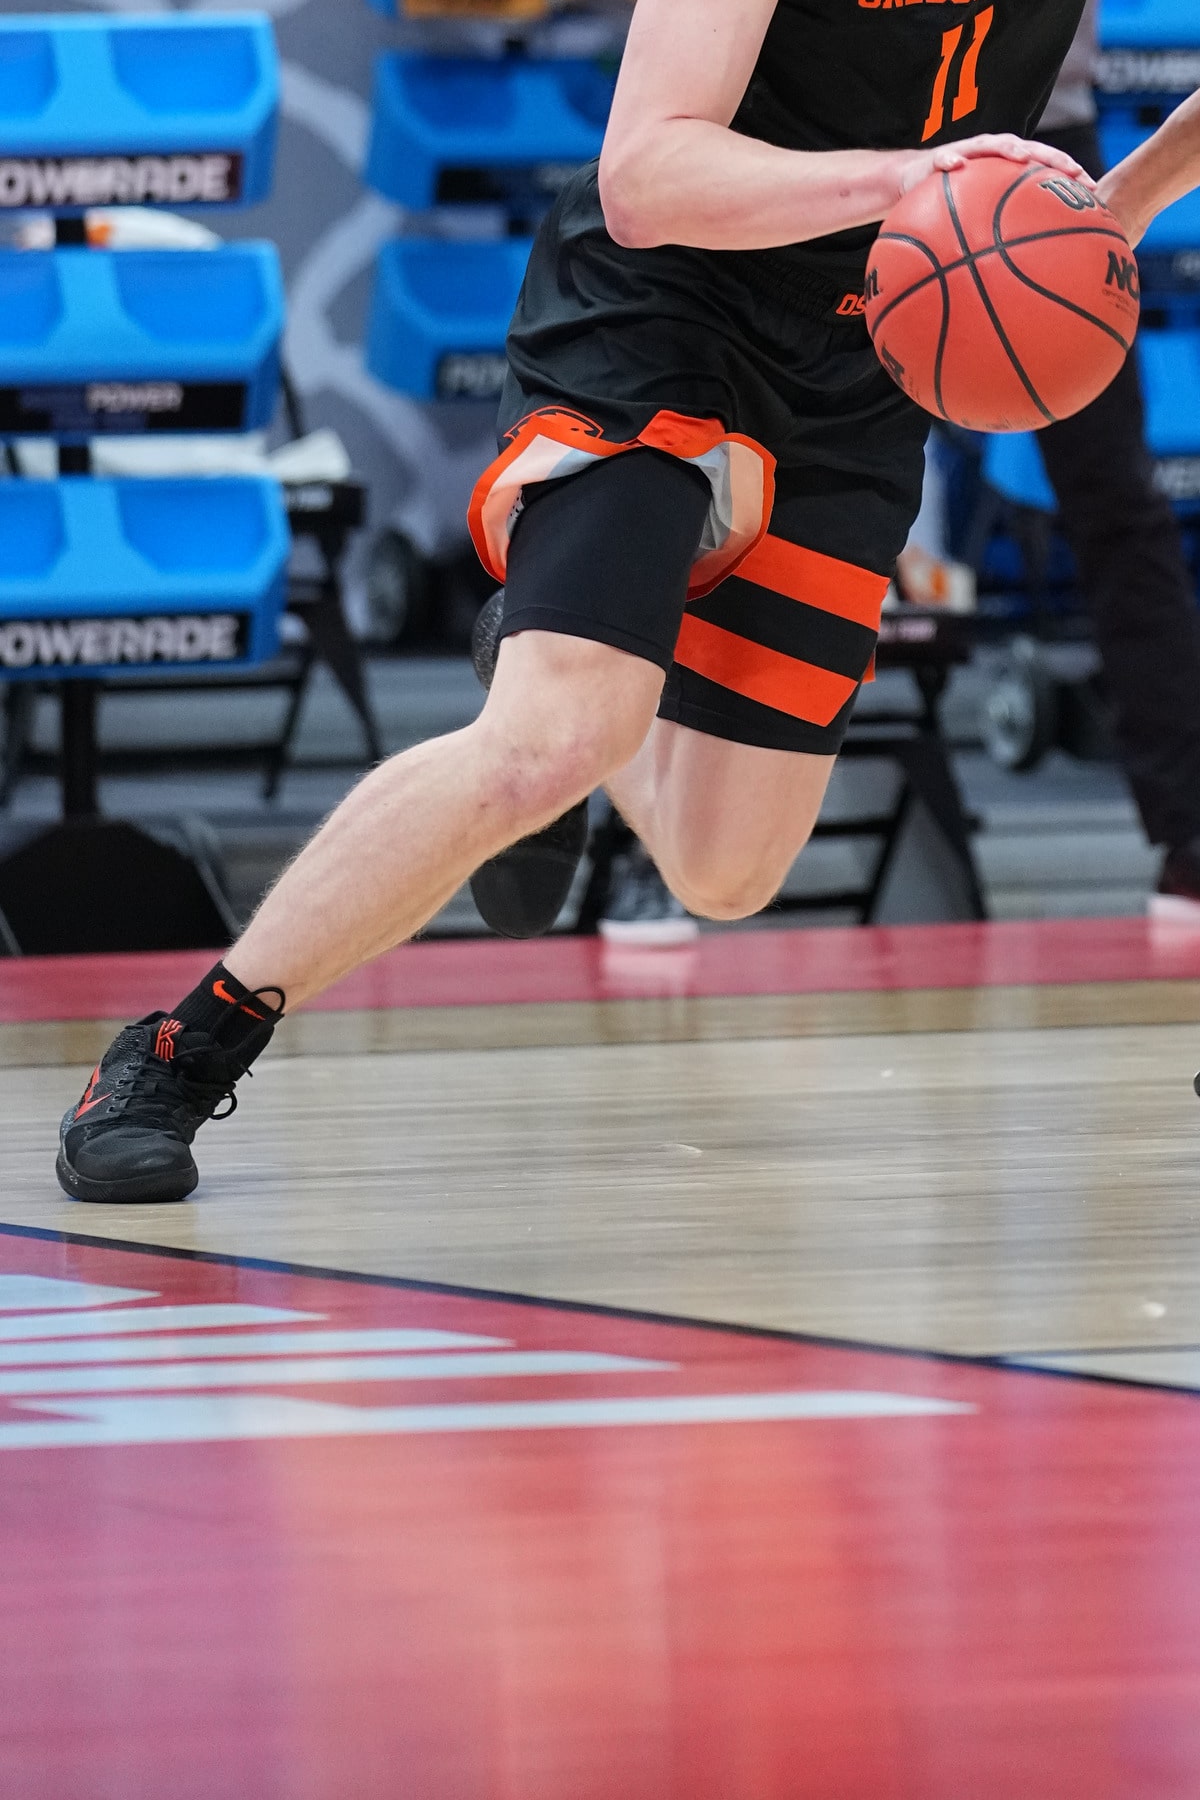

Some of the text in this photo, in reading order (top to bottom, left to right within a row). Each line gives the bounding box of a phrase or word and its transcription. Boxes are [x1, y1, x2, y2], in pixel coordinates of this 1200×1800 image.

[920, 4, 994, 143] 11
[0, 154, 232, 205] OWERADE
[1105, 250, 1139, 302] NC
[0, 614, 239, 668] OWERADE
